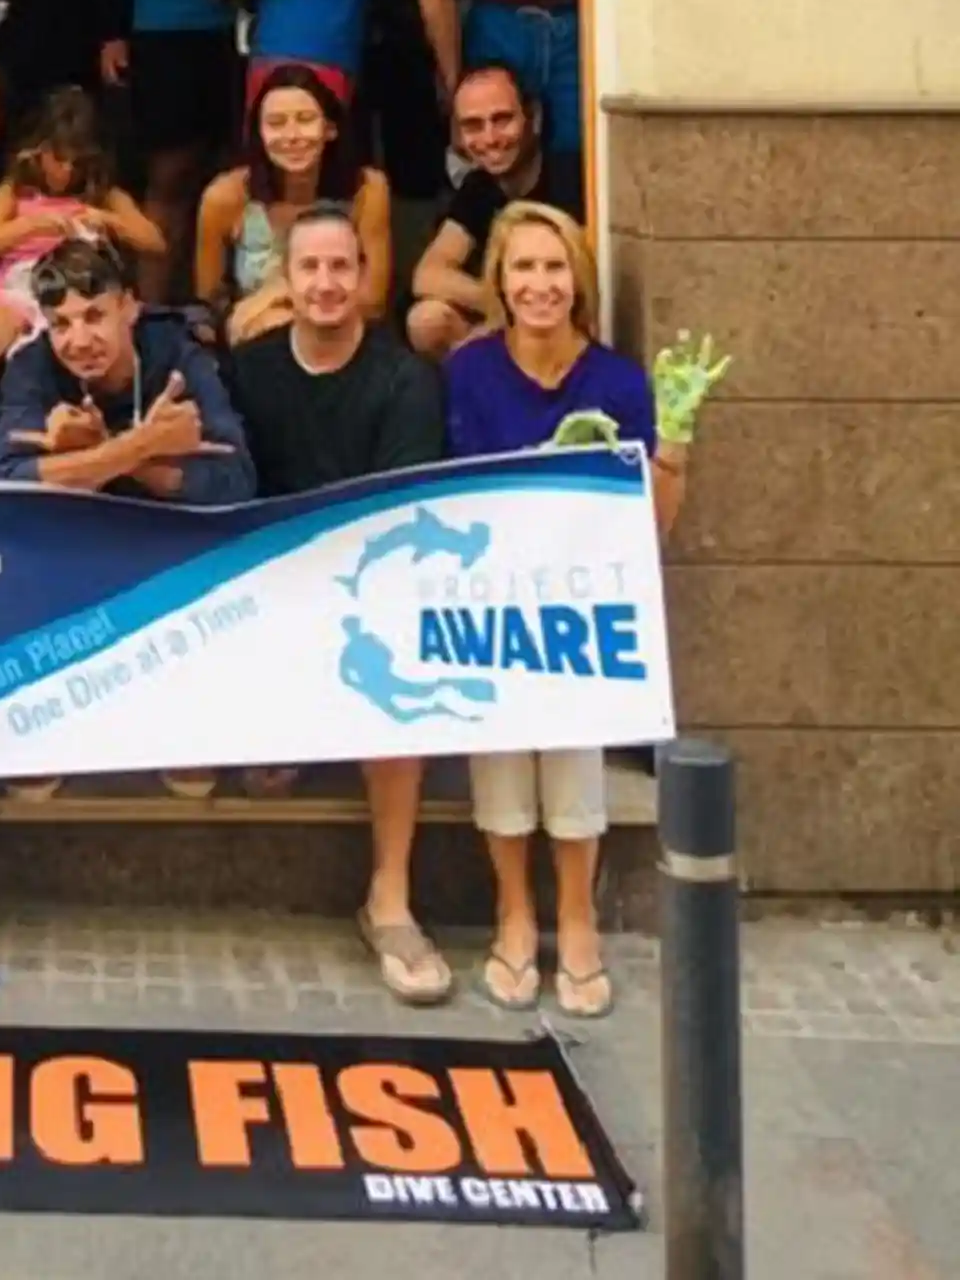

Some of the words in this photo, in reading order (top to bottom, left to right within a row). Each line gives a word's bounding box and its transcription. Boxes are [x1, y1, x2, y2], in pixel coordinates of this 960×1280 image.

[7, 696, 65, 736] One
[65, 658, 133, 709] Dive
[135, 634, 164, 674] at
[188, 593, 260, 648] Time
[24, 606, 116, 675] Planet
[420, 604, 647, 680] AWARE
[187, 1060, 596, 1179] FISH
[363, 1173, 458, 1207] DIVE
[461, 1176, 610, 1214] CENTER
